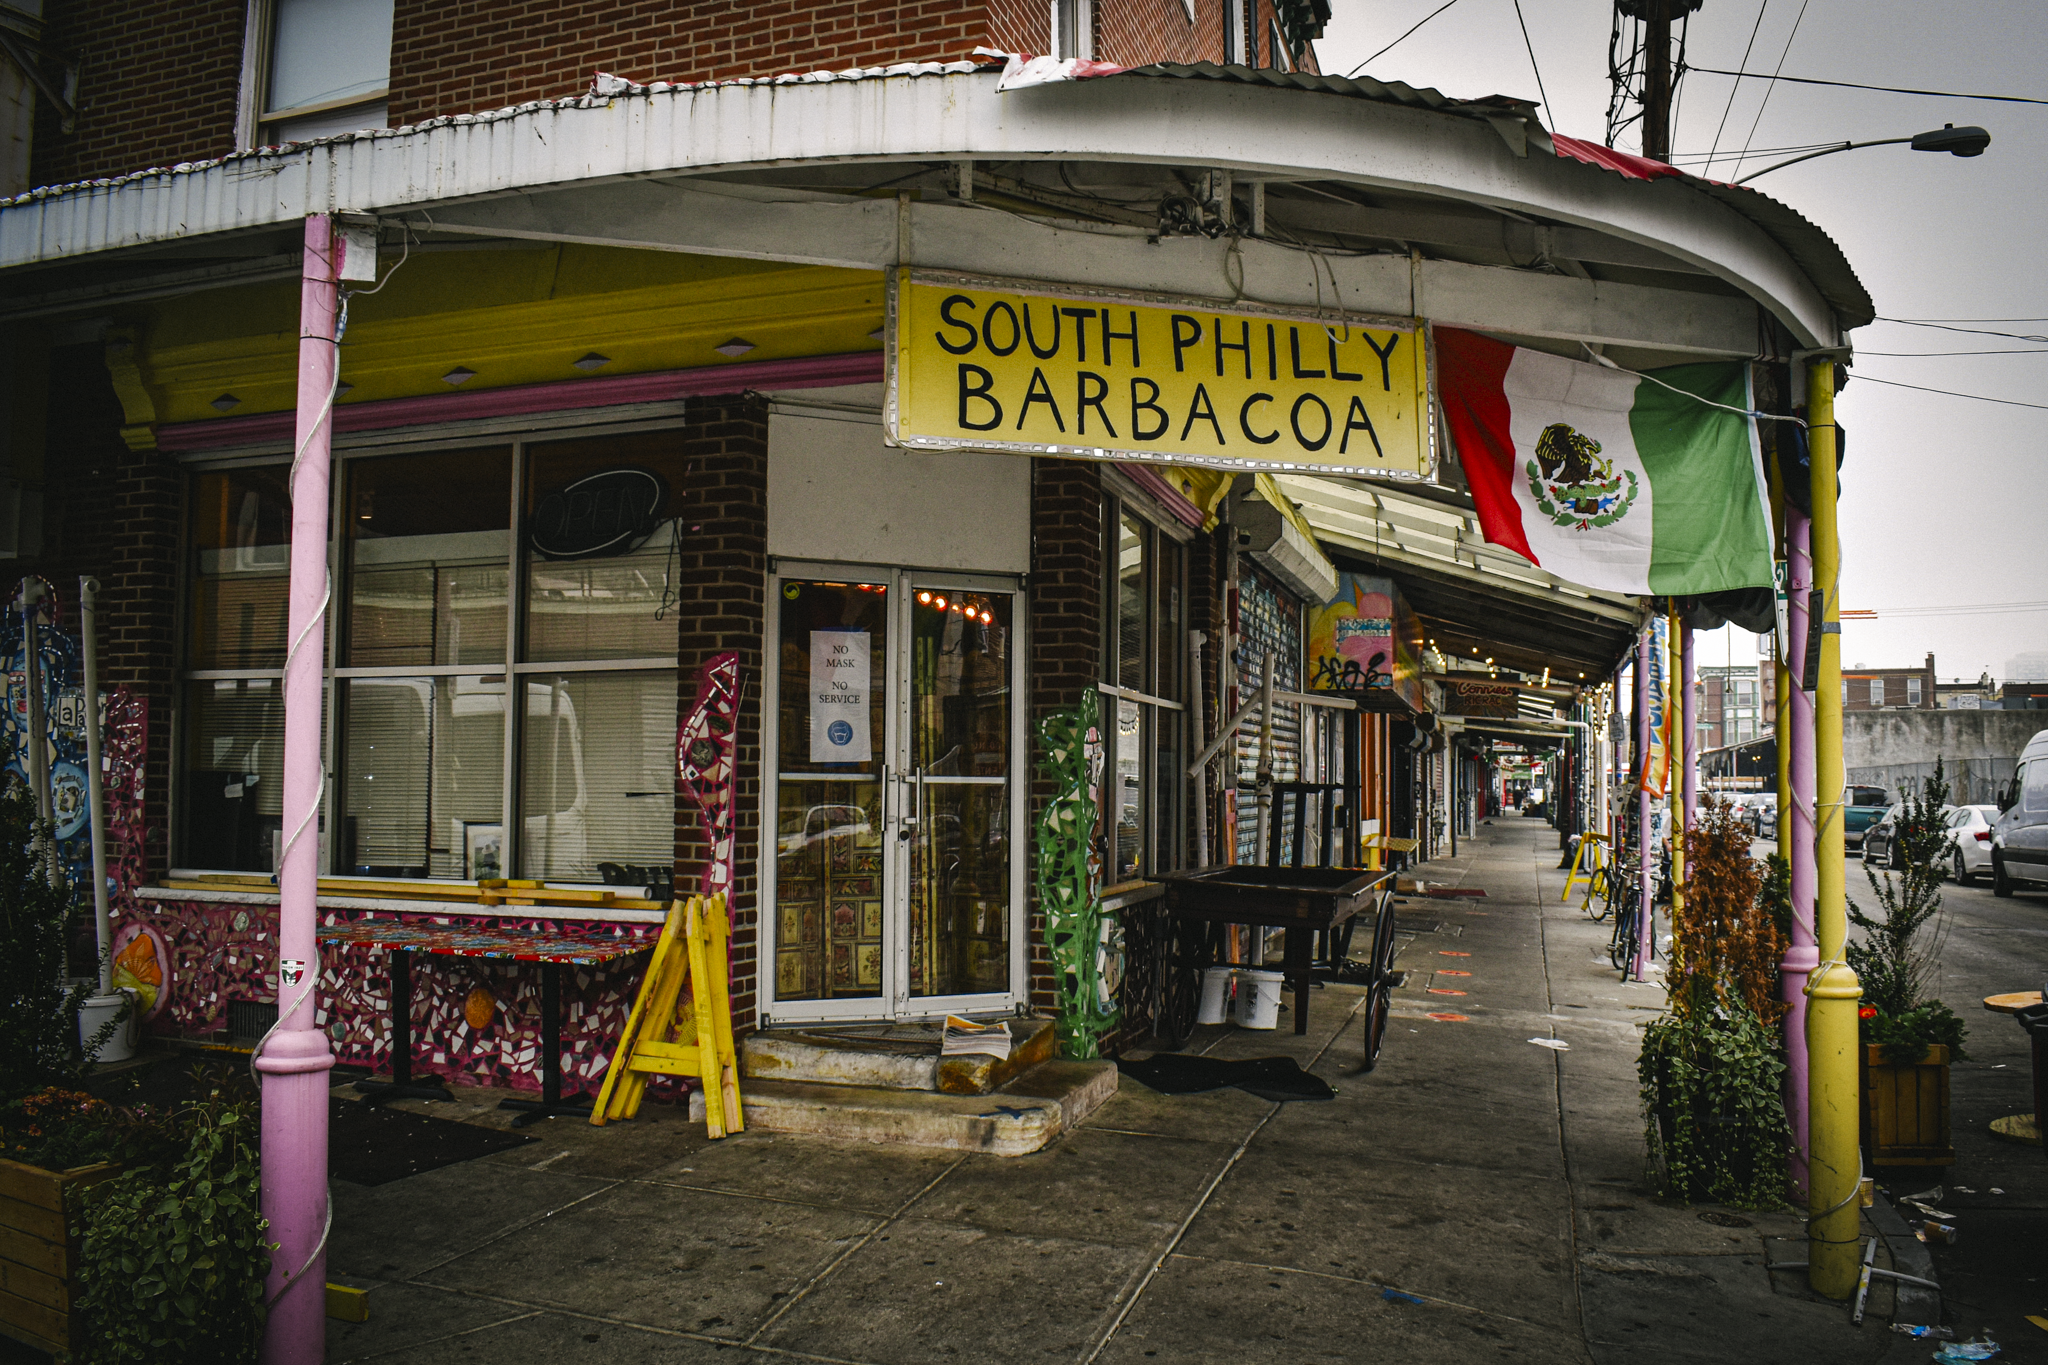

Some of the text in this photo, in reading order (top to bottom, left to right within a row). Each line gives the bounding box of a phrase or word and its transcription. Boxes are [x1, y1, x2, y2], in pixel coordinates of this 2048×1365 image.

[935, 294, 1399, 391] SOUTH PHILLY
[957, 363, 1384, 458] BARBACOA
[535, 487, 648, 539] OPEN
[833, 645, 849, 655] NO
[826, 658, 855, 668] MASK
[832, 681, 848, 691] NO
[819, 694, 861, 704] SERVICE
